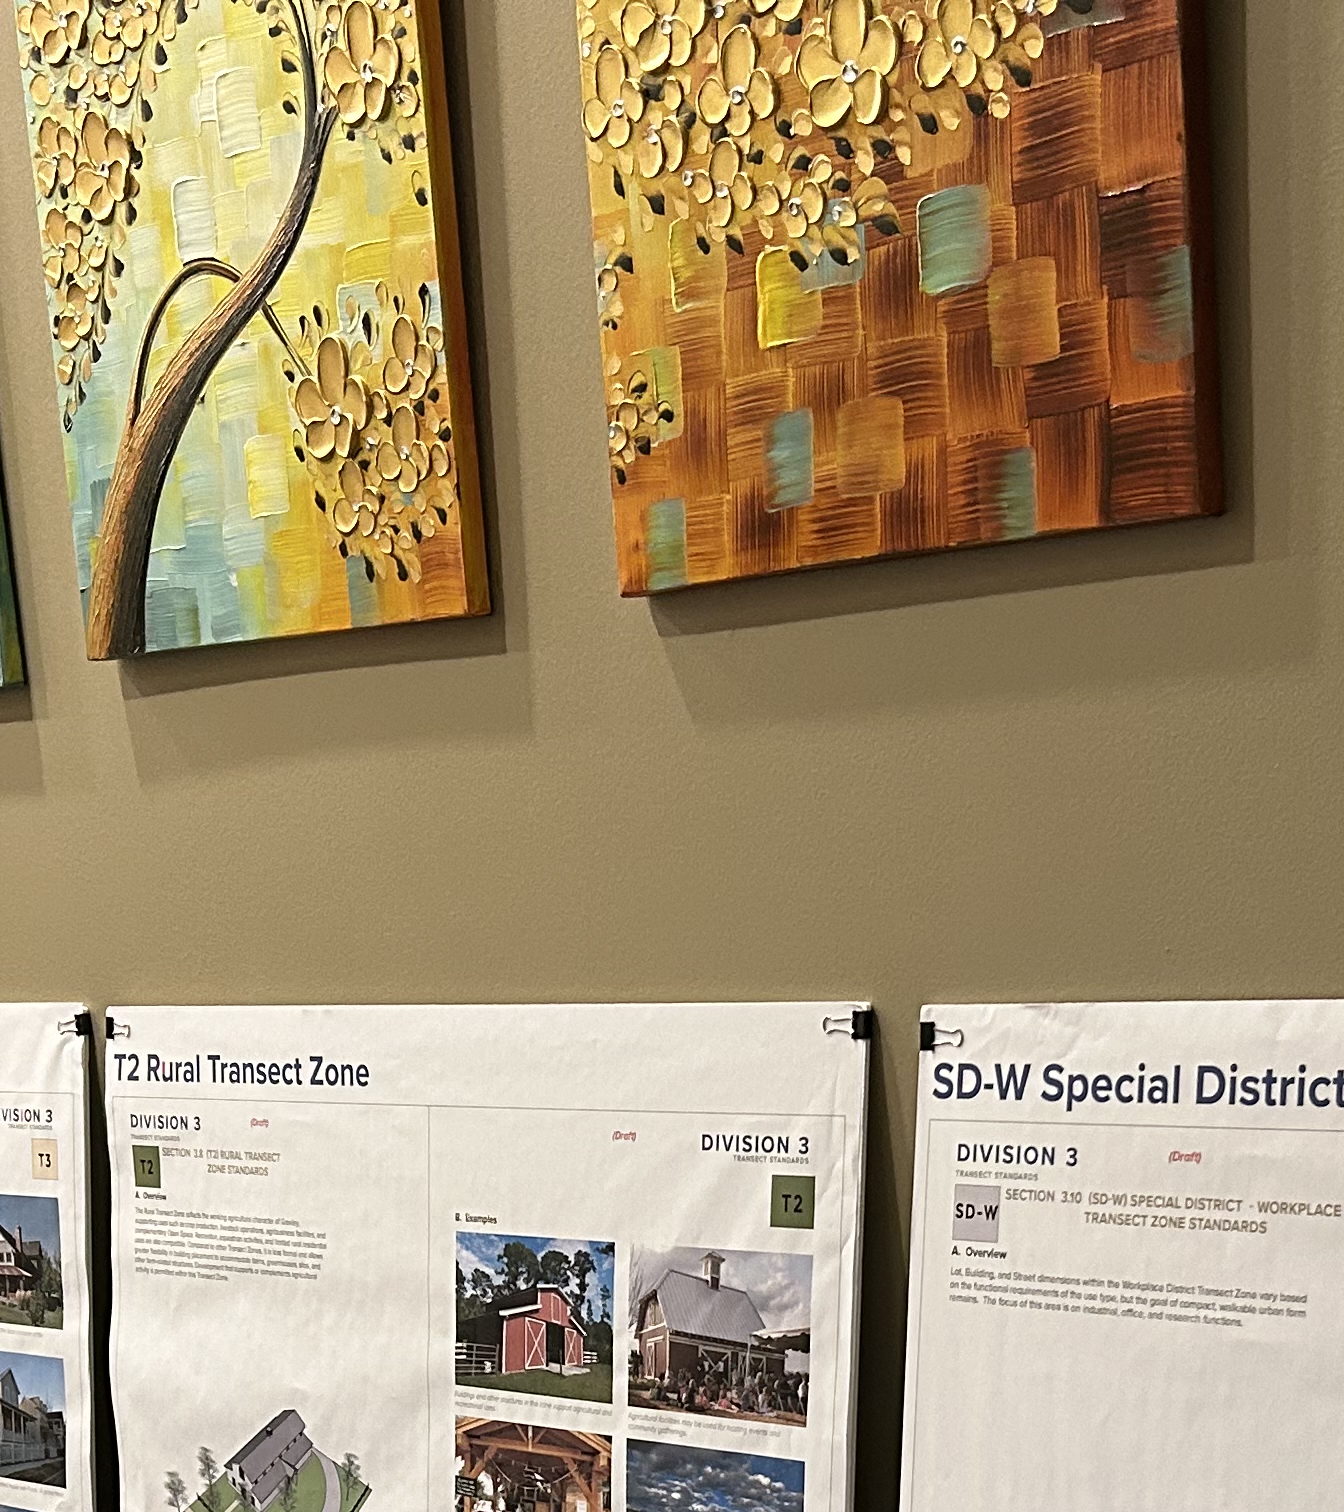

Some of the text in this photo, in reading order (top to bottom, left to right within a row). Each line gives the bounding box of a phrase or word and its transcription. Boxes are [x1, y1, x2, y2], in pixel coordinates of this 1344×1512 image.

[114, 1053, 370, 1087] T2 Rural Transect Zone
[932, 1062, 1032, 1100] SD-W
[1040, 1062, 1180, 1112] Special
[46, 1109, 52, 1123] 3
[130, 1114, 200, 1131] DIVISION 3
[702, 1133, 808, 1154] DIVISION 3
[38, 1153, 52, 1168] T3
[958, 1143, 1078, 1167] DIVISION 3
[1168, 1150, 1202, 1164] (Draft)
[140, 1160, 154, 1175] T2
[782, 1194, 803, 1213] T2
[956, 1202, 998, 1220] SD-W
[1004, 1188, 1056, 1203] SECTION
[1130, 1194, 1182, 1209] SPECIAL
[1184, 1197, 1244, 1213] DISTRICT
[1258, 1200, 1342, 1218] WORKPLACE
[1084, 1212, 1268, 1234] TRANSECT ZONE STANDARDS
[952, 1245, 1008, 1260] A. Overview
